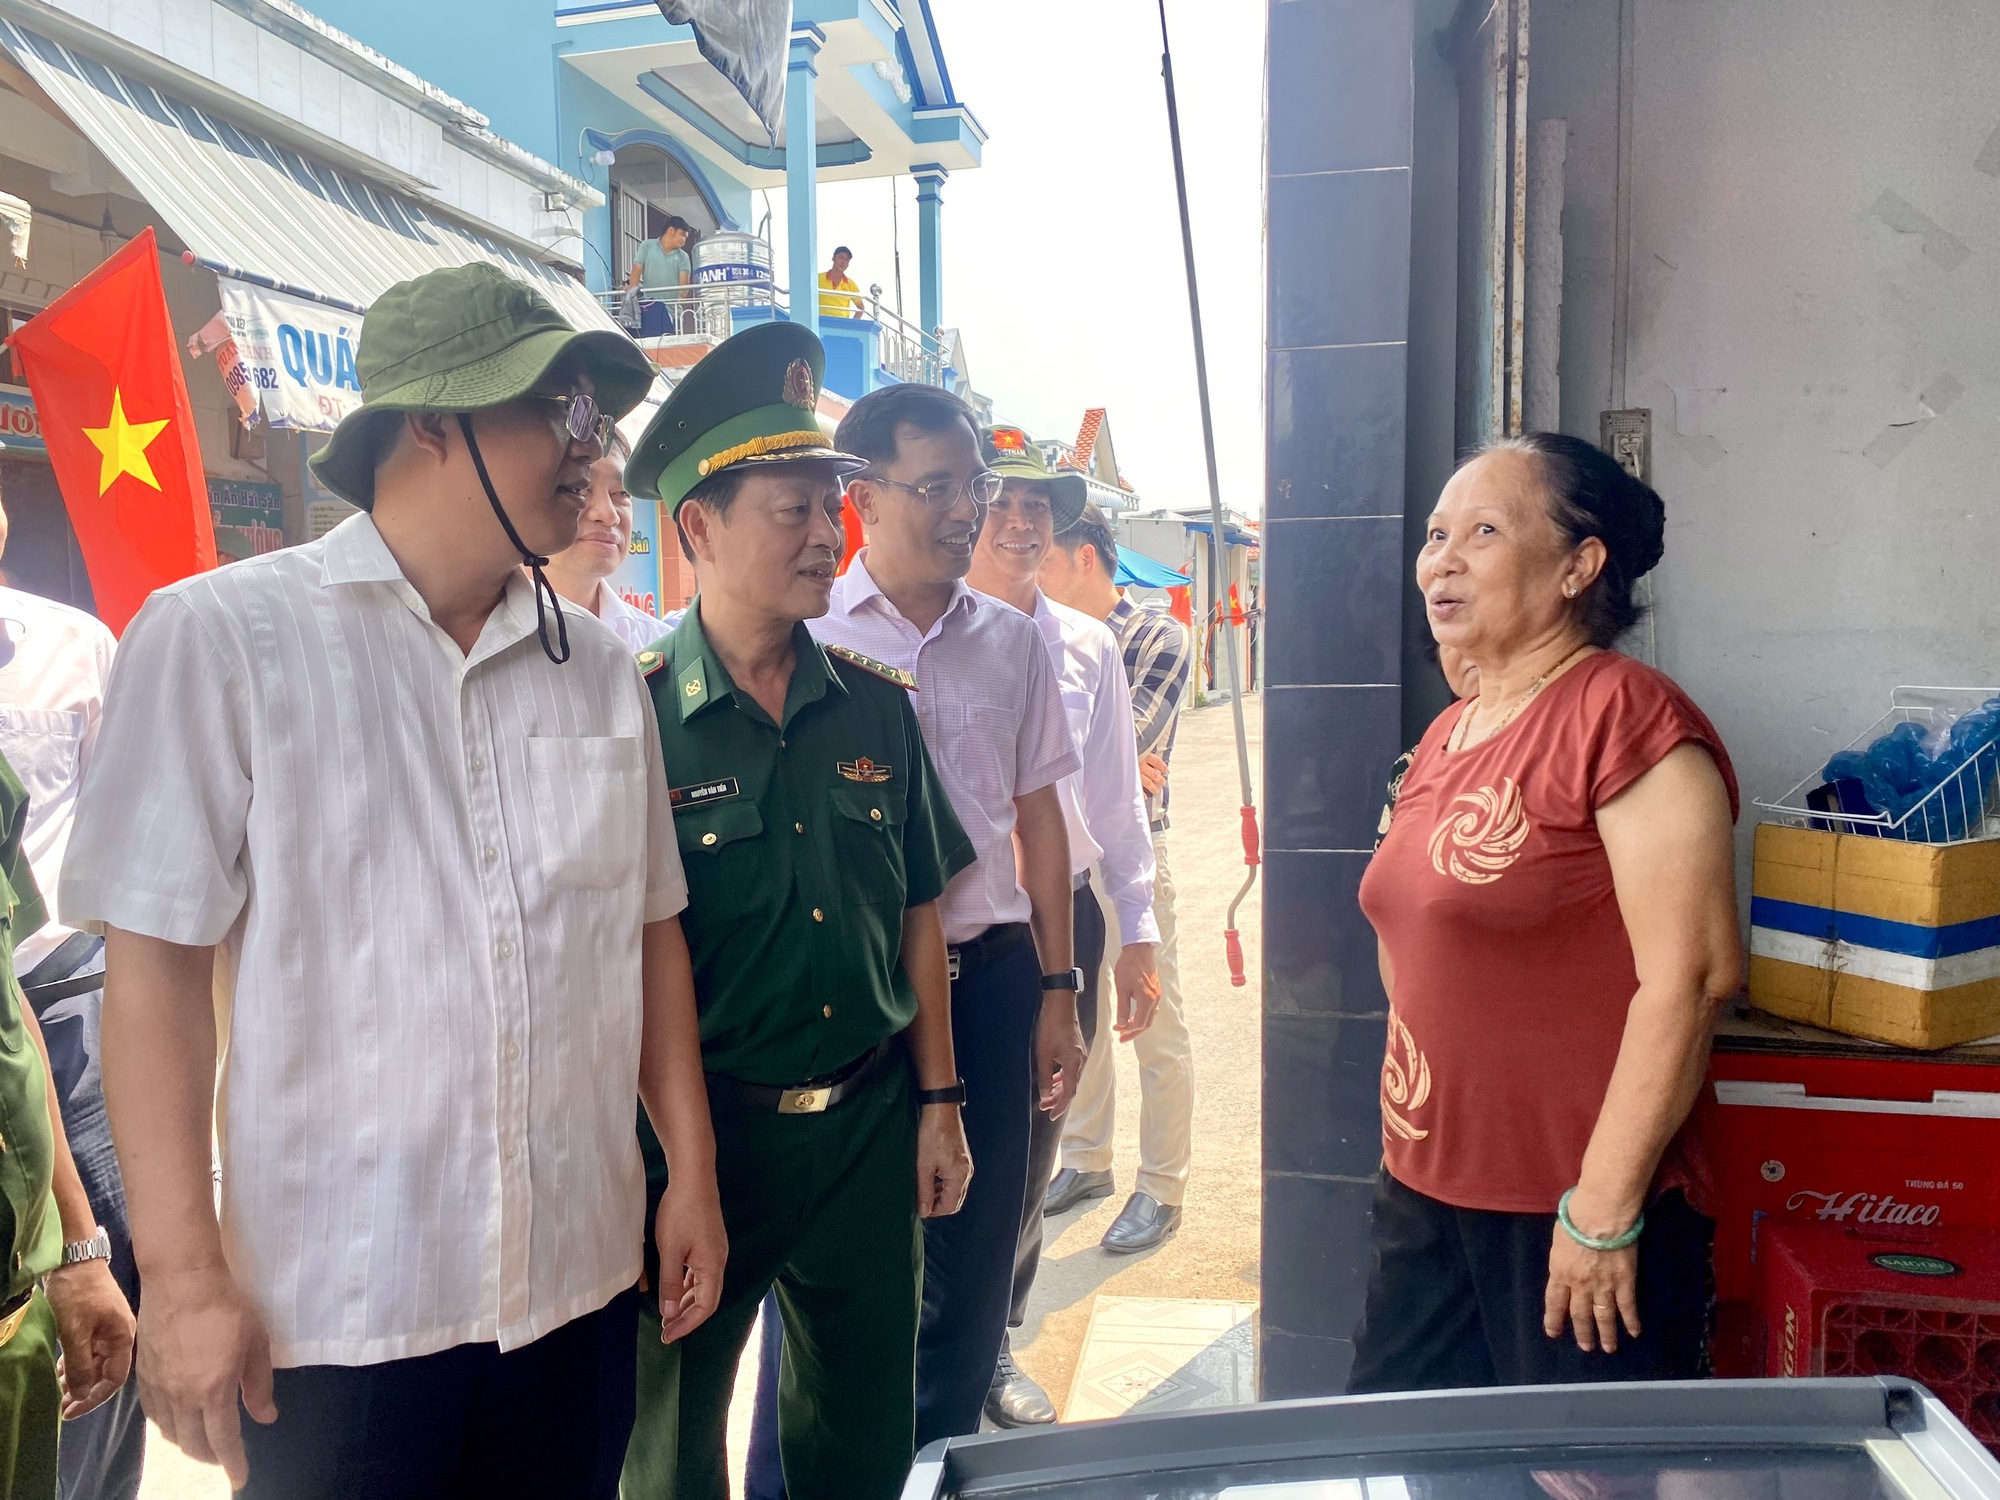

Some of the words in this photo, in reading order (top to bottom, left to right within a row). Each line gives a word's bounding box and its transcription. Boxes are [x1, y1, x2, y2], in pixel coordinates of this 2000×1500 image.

[277, 326, 362, 393] QUÁ
[253, 367, 279, 389] 682
[1952, 1181, 1964, 1190] 50
[1786, 1190, 1940, 1226] Hitaco
